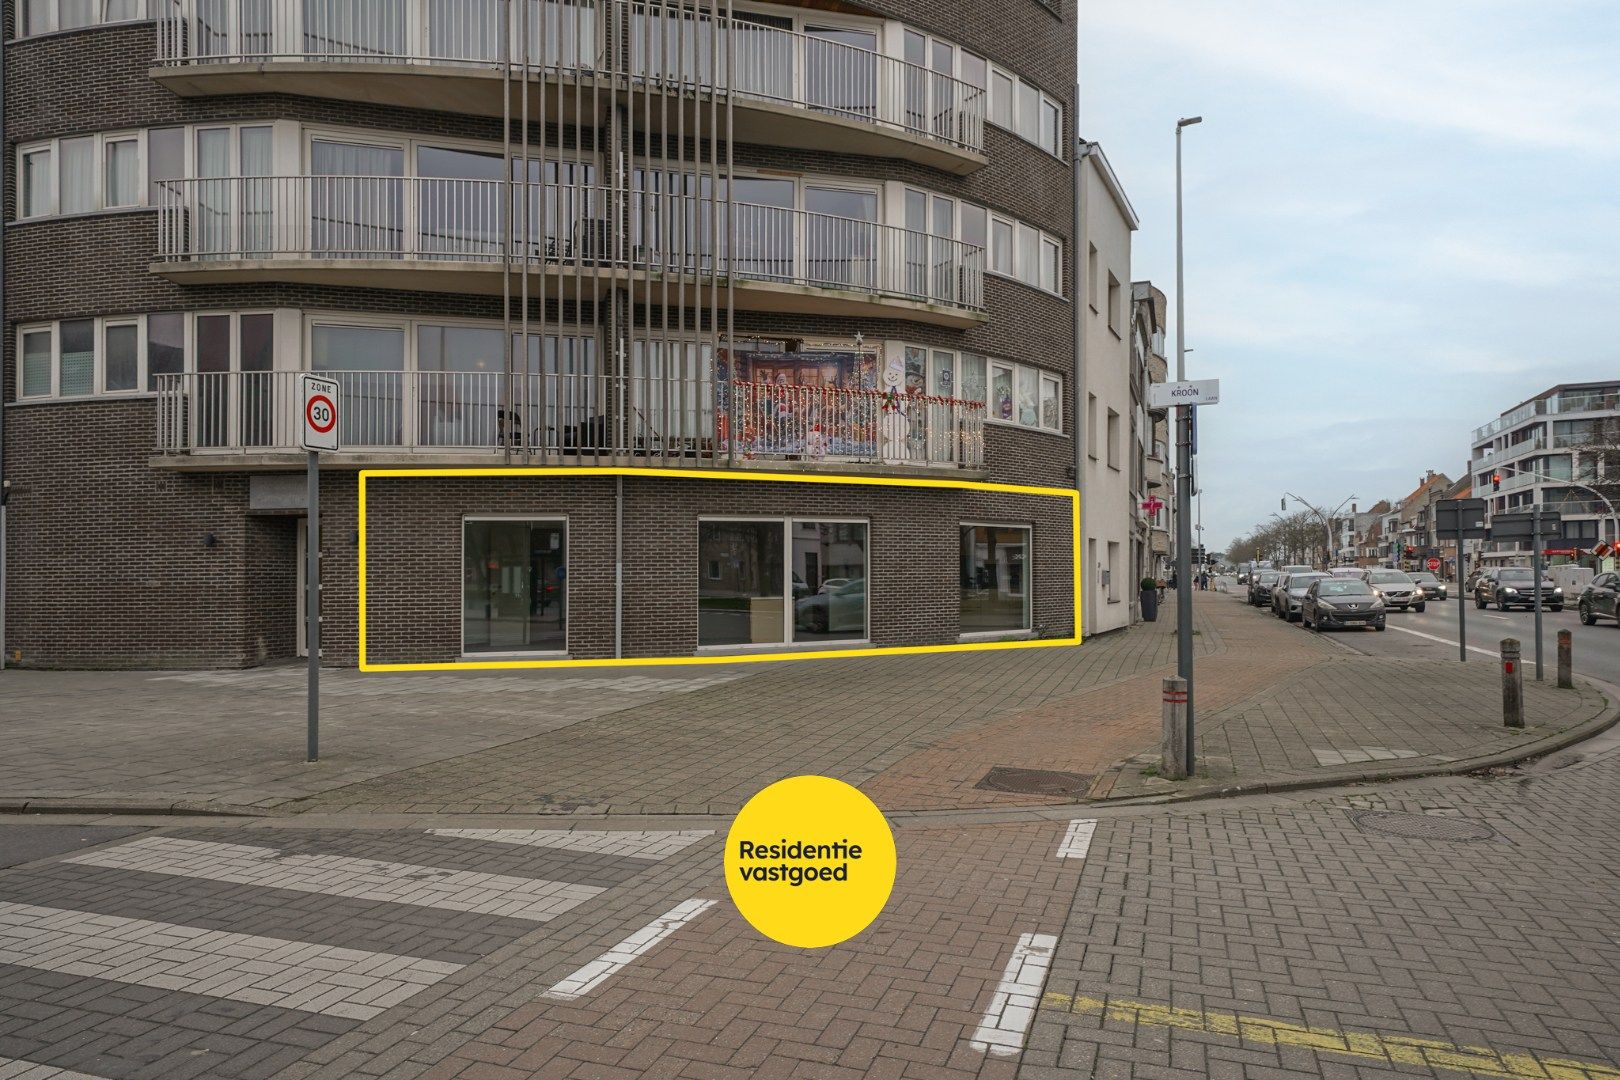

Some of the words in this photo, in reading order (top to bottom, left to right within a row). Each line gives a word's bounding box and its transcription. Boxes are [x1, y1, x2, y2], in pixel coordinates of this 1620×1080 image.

[311, 382, 331, 394] ZONE
[1171, 388, 1199, 398] KROON
[313, 406, 330, 422] 30
